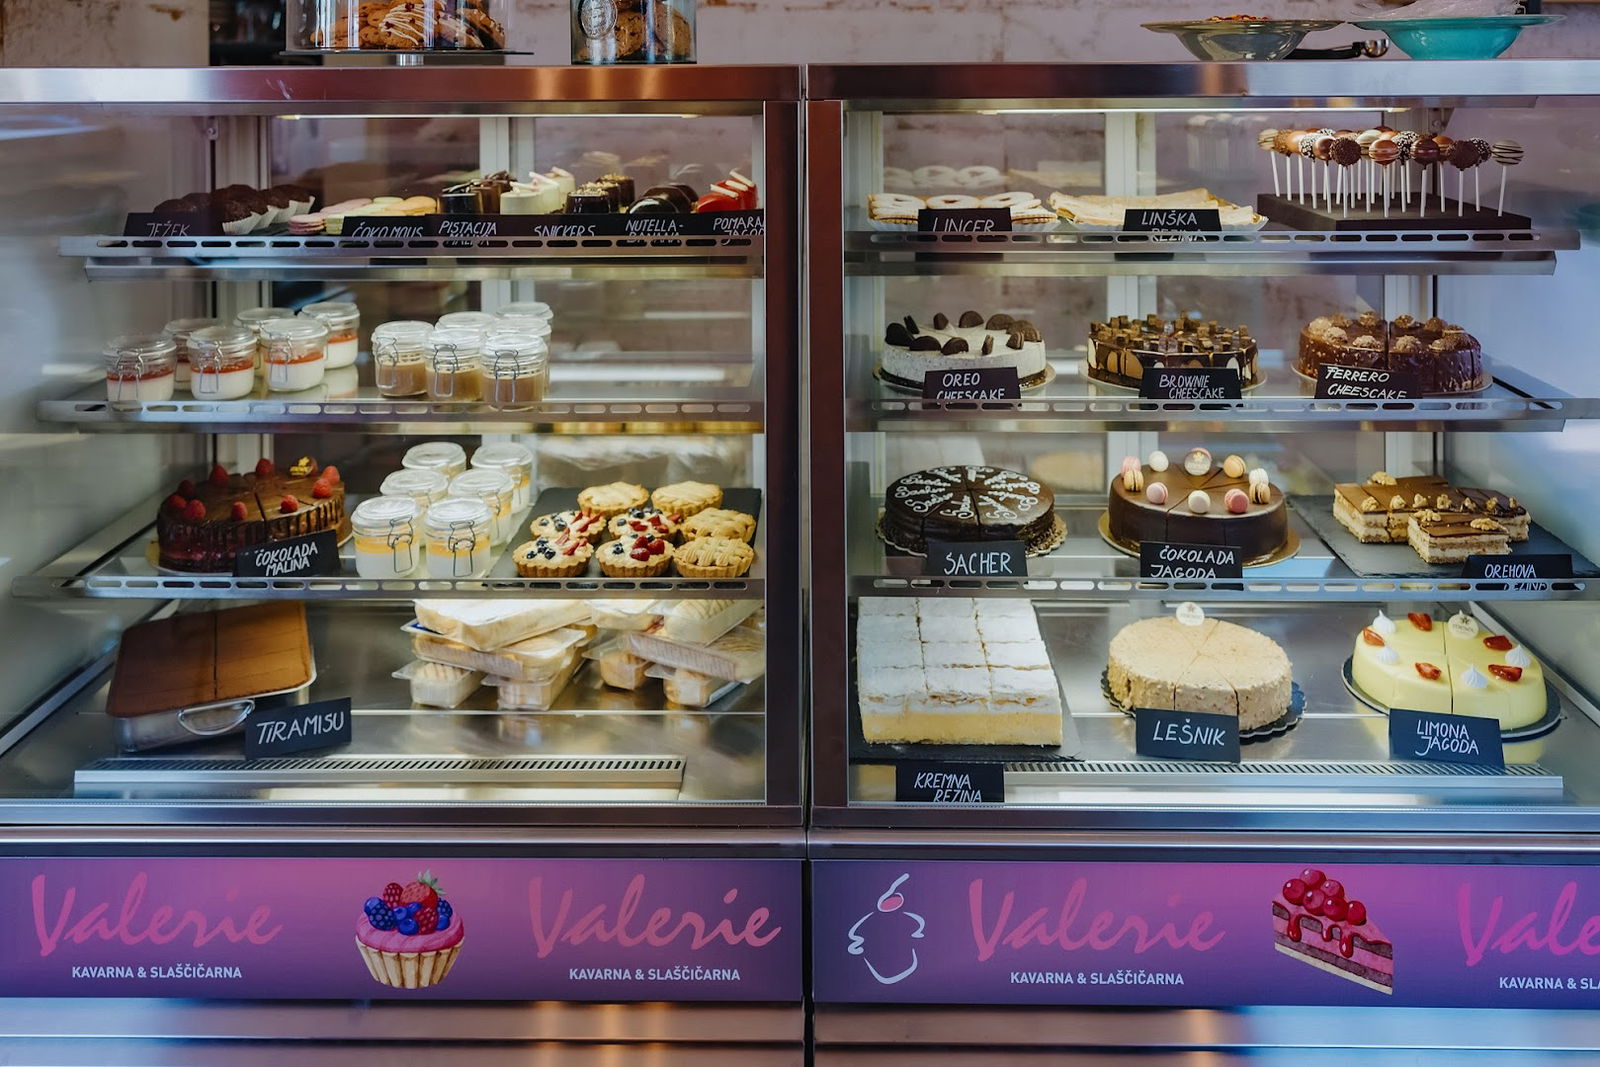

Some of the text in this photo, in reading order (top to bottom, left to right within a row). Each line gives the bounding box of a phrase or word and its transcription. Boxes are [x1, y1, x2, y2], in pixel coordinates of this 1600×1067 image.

[1141, 210, 1198, 226] LINŠKA
[146, 220, 191, 237] JEŽEK
[438, 220, 497, 236] PISTACIJA
[534, 224, 596, 236] SNICKERS
[942, 372, 981, 387] OREO
[1159, 374, 1211, 388] BROWNIE
[1325, 366, 1390, 382] FERRERO
[1168, 387, 1226, 399] CHEESCAKE
[255, 541, 318, 567] ČOKOLADA
[1159, 545, 1235, 565] ČOKOLADA
[265, 556, 311, 577] MALINA
[943, 551, 1013, 575] SACHER
[1150, 563, 1216, 579] JAGODA
[1484, 563, 1537, 579] OREHOVA
[1152, 718, 1226, 746] LEŠNIK
[1416, 719, 1470, 740] LIMONA
[1414, 735, 1480, 757] JAGODA
[914, 772, 972, 790] KREMNA
[933, 788, 982, 803] REZINA
[31, 871, 284, 957] Valerie
[528, 873, 782, 958] Valerie
[968, 876, 1226, 962] Valerie
[72, 963, 242, 978] KAVARNA & SLAŠČIČARNA
[569, 965, 741, 980] KAVARNA & SLAŠČIČARNA
[1010, 969, 1185, 985] KAVARNA & SLAŠČIČARNA
[1499, 977, 1600, 989] KAVARNA & SL
